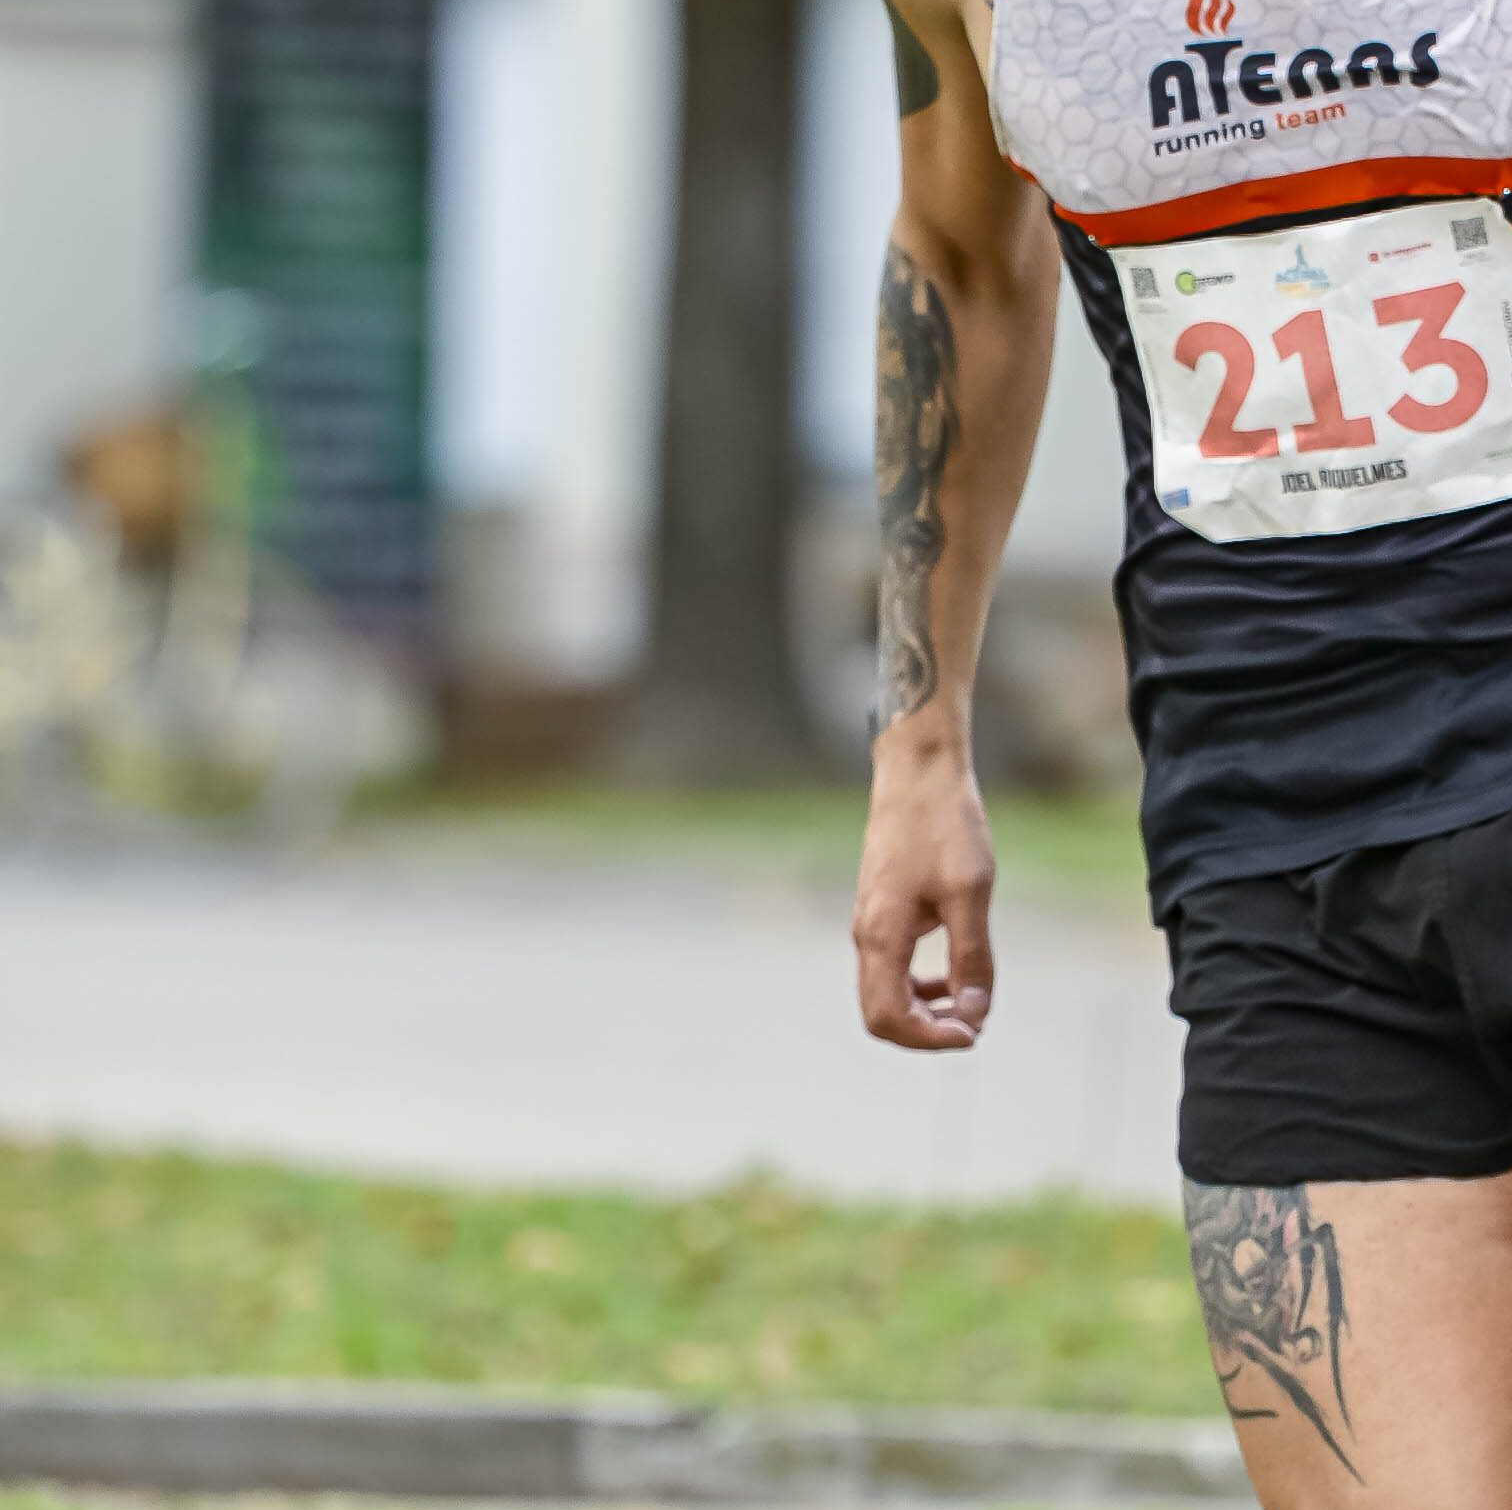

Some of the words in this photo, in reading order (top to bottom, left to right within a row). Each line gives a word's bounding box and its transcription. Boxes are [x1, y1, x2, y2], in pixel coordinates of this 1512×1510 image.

[1153, 118, 1266, 157] running
[1275, 102, 1348, 132] team
[1173, 280, 1490, 459] 213
